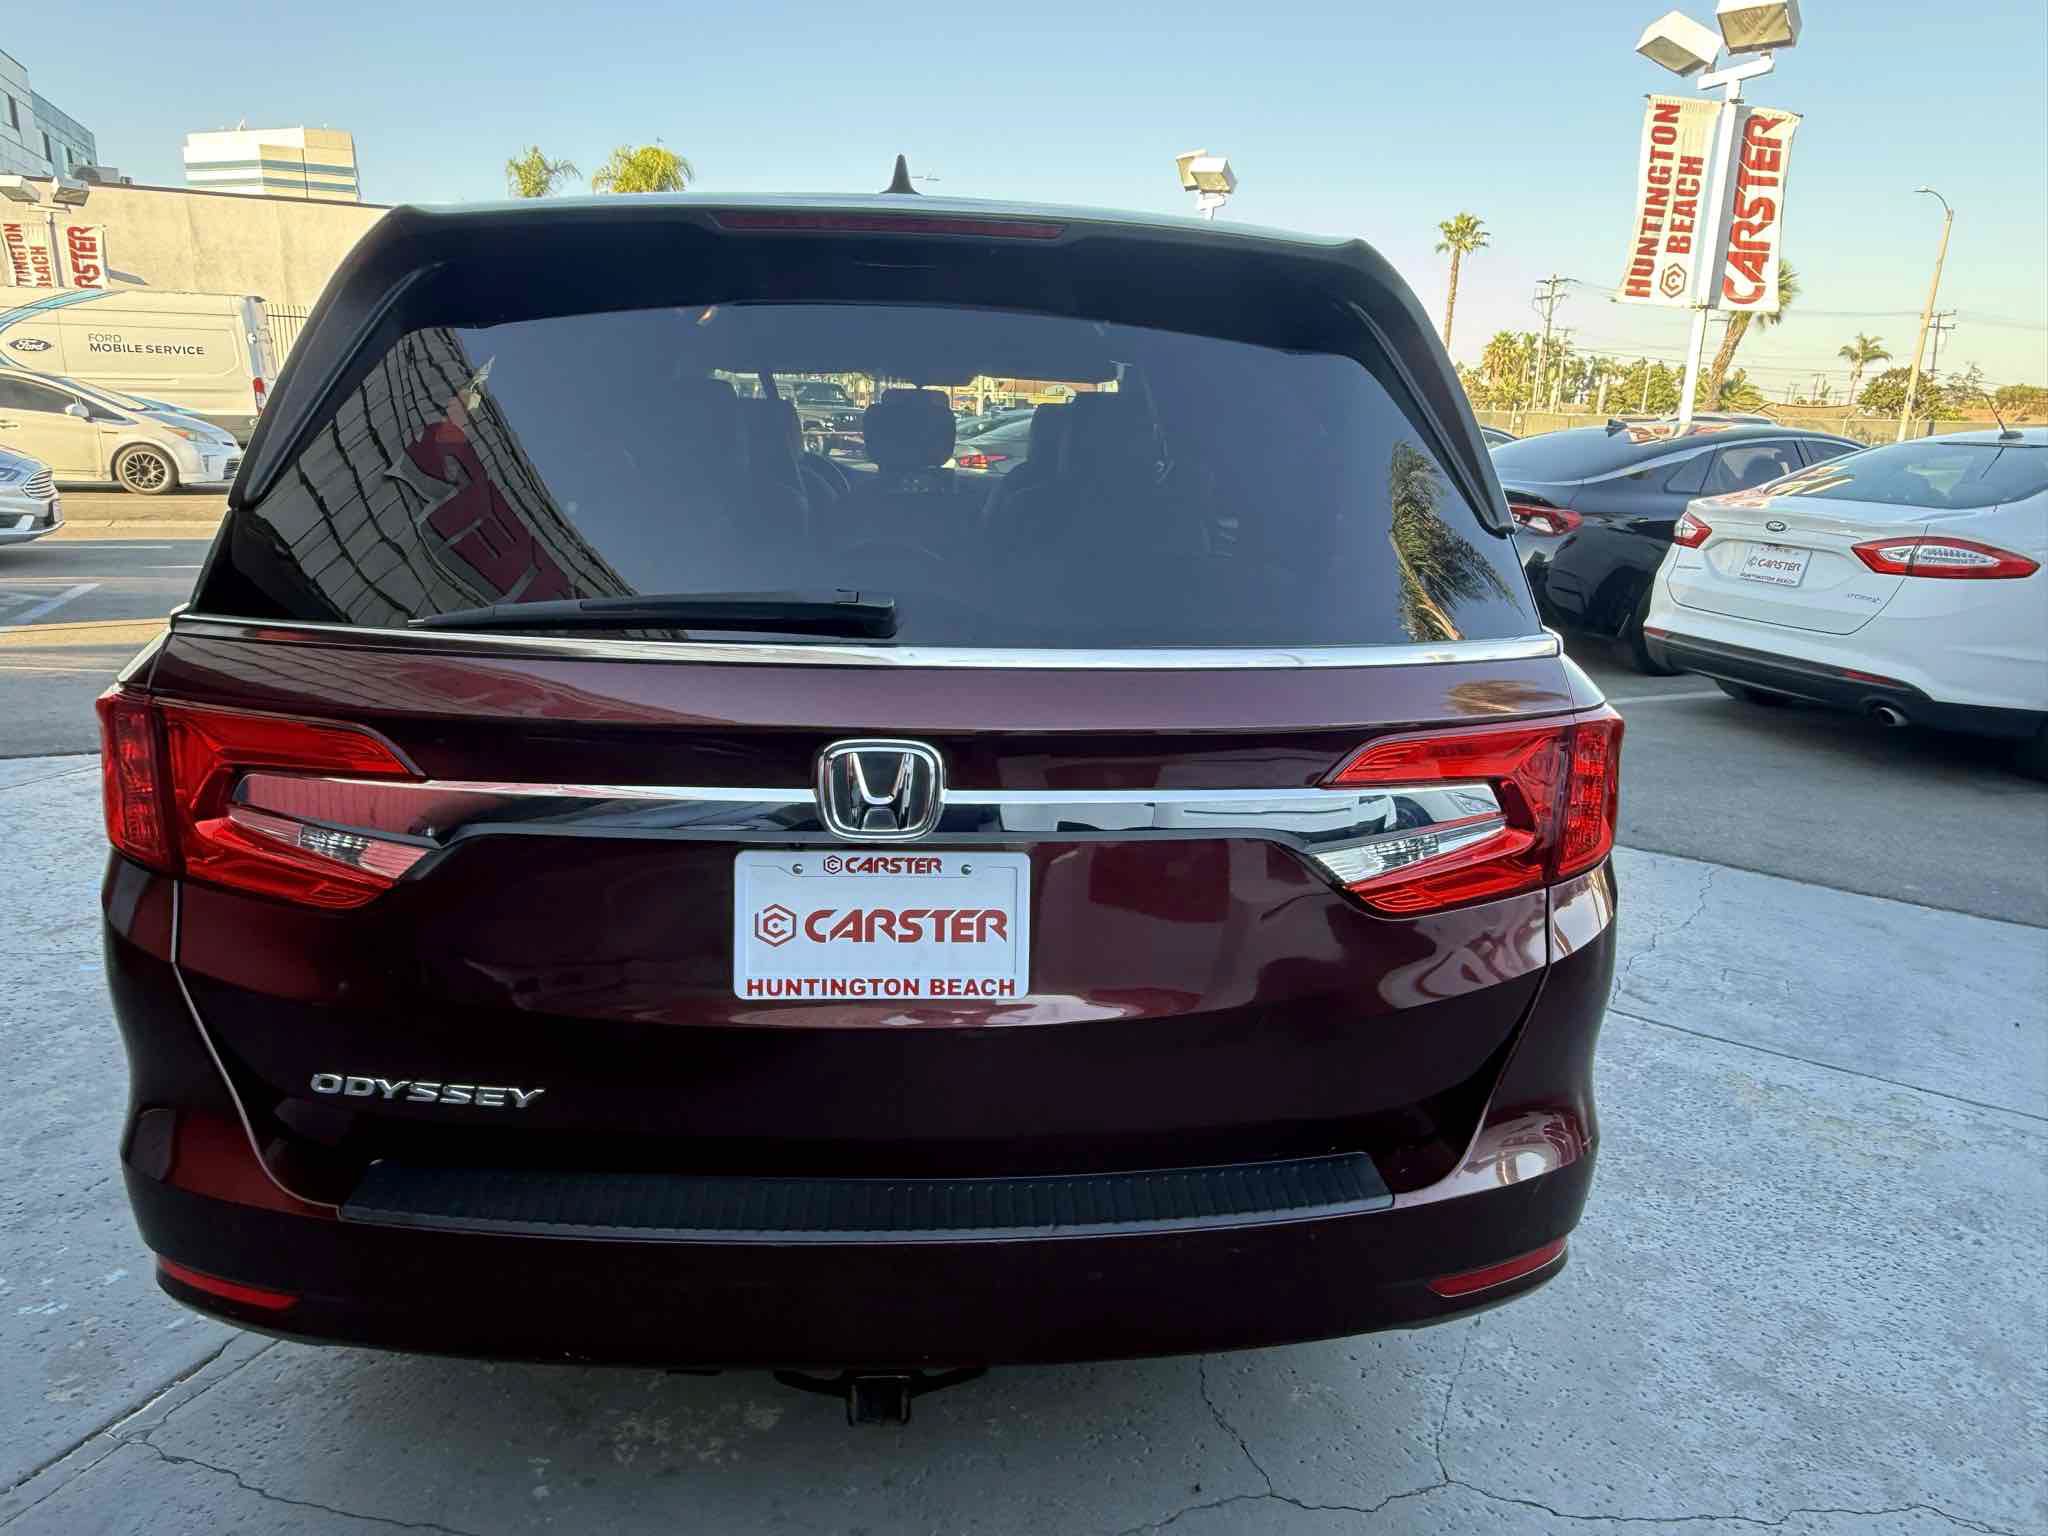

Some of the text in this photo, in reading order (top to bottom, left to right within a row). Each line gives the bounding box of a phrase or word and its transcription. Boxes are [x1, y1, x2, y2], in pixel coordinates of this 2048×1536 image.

[1624, 103, 1682, 298] HUNTINGTON
[1666, 155, 1705, 254] BEACH
[1722, 113, 1787, 305] CARSTER
[88, 333, 122, 343] FORD
[89, 343, 205, 355] MOBILE SERVICE
[845, 857, 942, 875] CARSTER
[804, 909, 1008, 944] CARSTER
[746, 978, 1016, 996] HUNTINGTON BEACH
[310, 1073, 545, 1109] ODYSSEY
